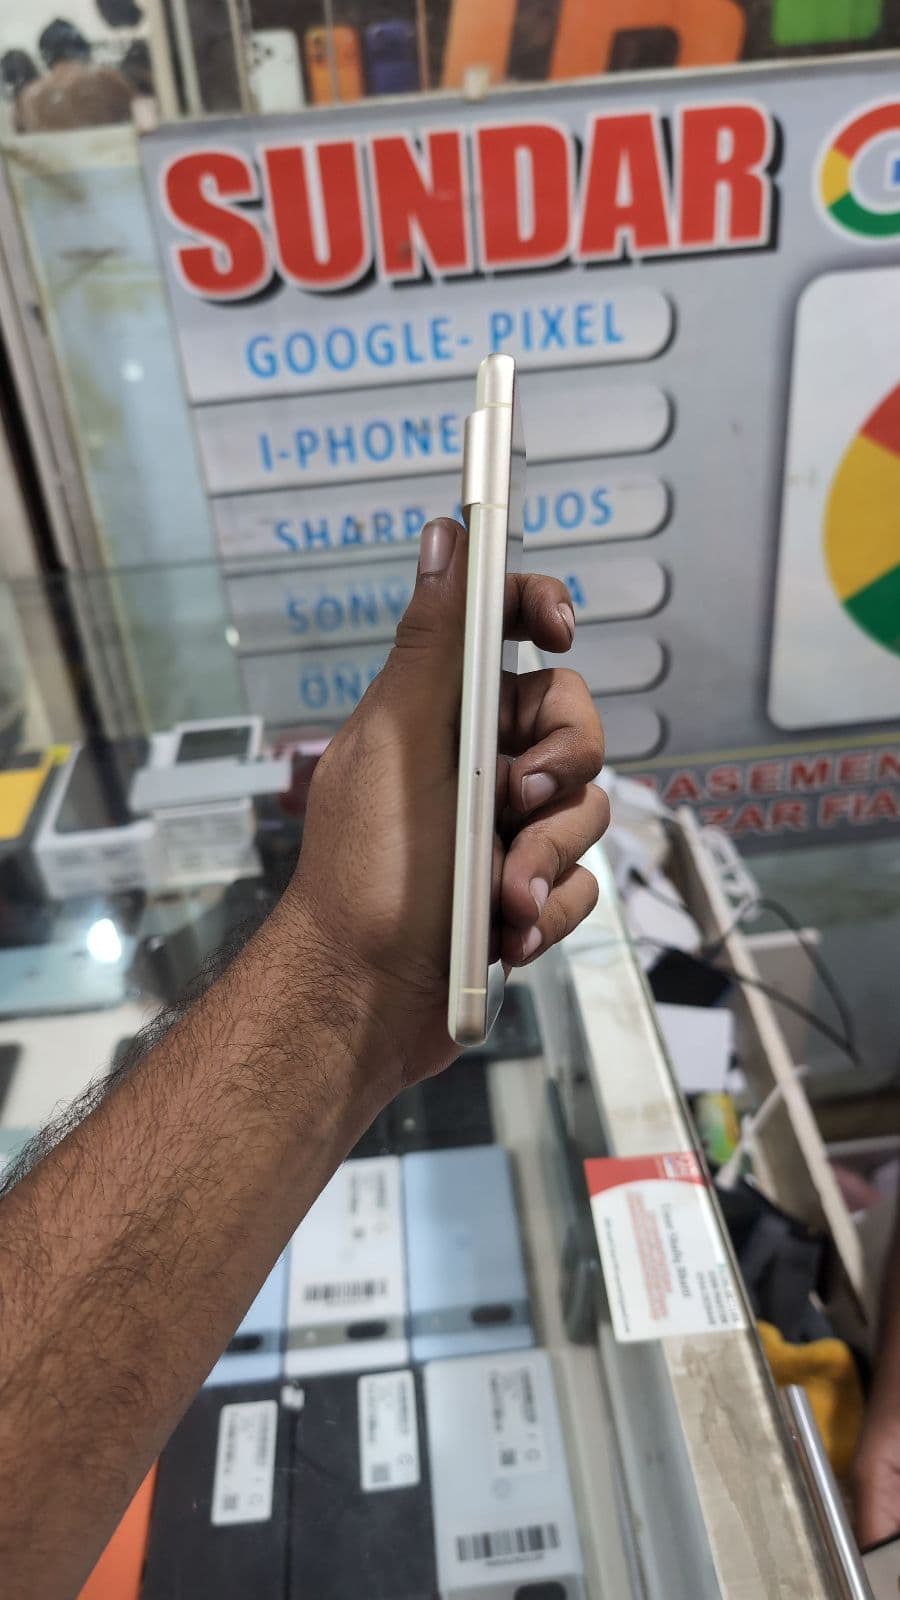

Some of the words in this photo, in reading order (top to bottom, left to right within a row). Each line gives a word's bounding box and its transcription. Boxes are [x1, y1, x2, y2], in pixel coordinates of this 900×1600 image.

[162, 101, 777, 302] SUNDAR
[245, 316, 474, 380] GOOGLE-
[489, 303, 625, 353] PIXEL
[259, 413, 462, 472] I-PHONE
[275, 505, 426, 550] SHARP
[299, 661, 384, 709] ON
